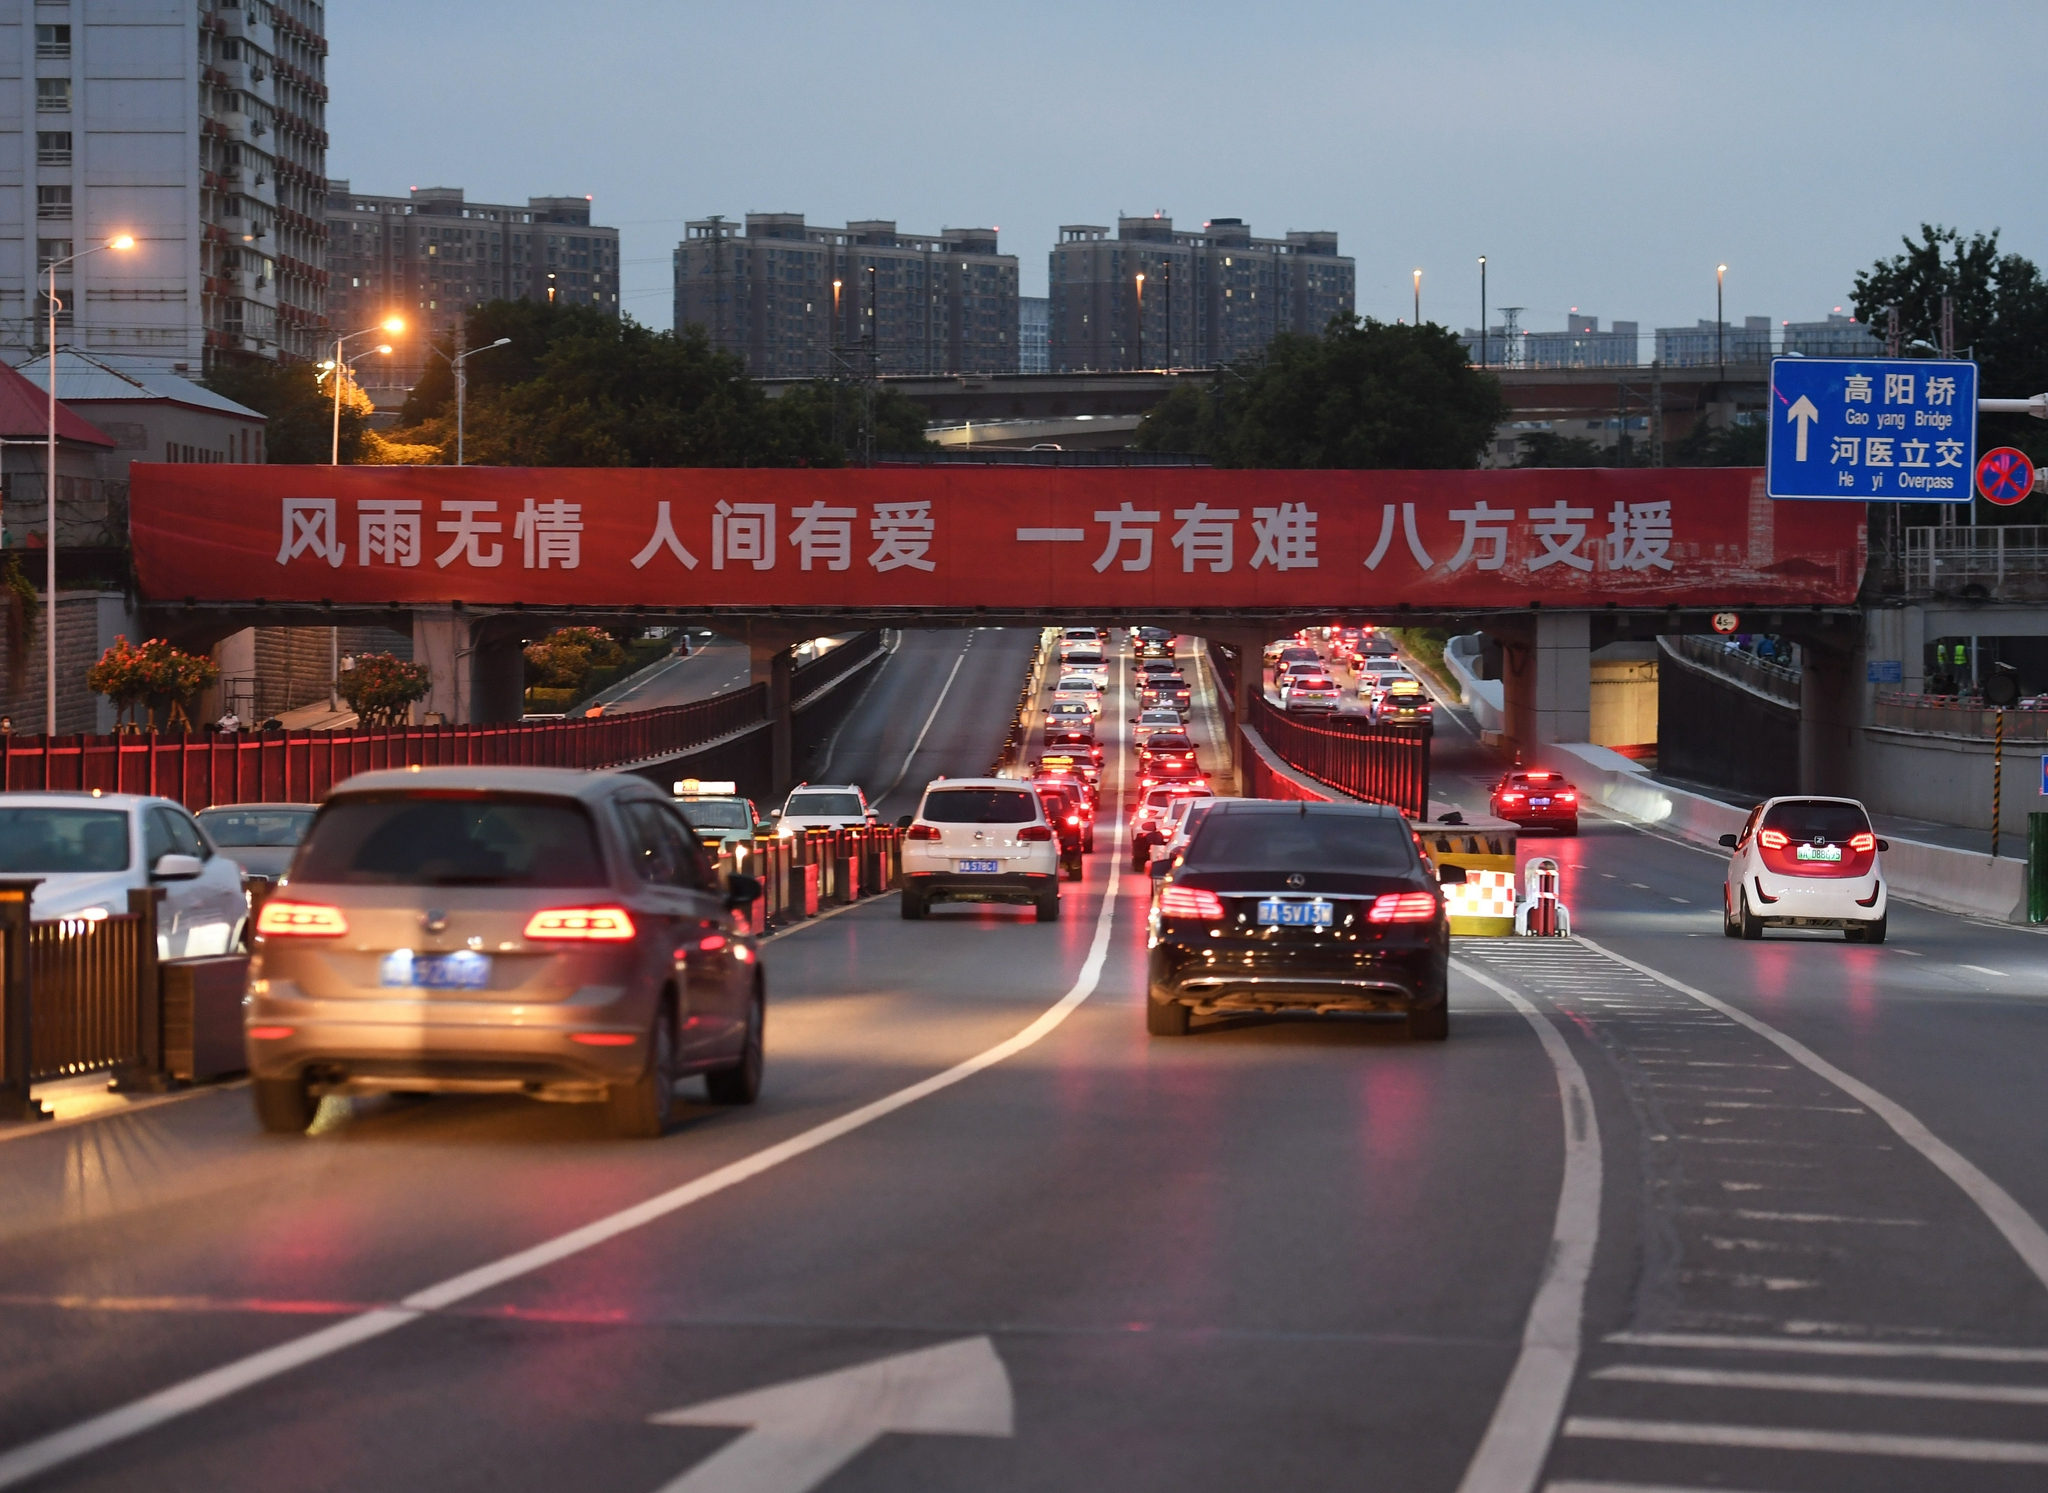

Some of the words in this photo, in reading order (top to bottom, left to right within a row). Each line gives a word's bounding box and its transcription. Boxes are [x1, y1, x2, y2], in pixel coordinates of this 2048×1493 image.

[1844, 373, 1957, 406] 高阳桥
[1845, 408, 1870, 425] Gao
[1877, 413, 1906, 430] yang
[1914, 410, 1953, 431] Bridge
[1830, 435, 1965, 468] 河医立交
[1838, 470, 1855, 487] He
[1871, 472, 1883, 491] yi
[1898, 471, 1954, 492] Overpass
[275, 497, 585, 570] 风雨无情
[629, 499, 938, 574] 人间有爱
[1016, 500, 1320, 574] 一方有难
[1363, 500, 1675, 574] 八方支援
